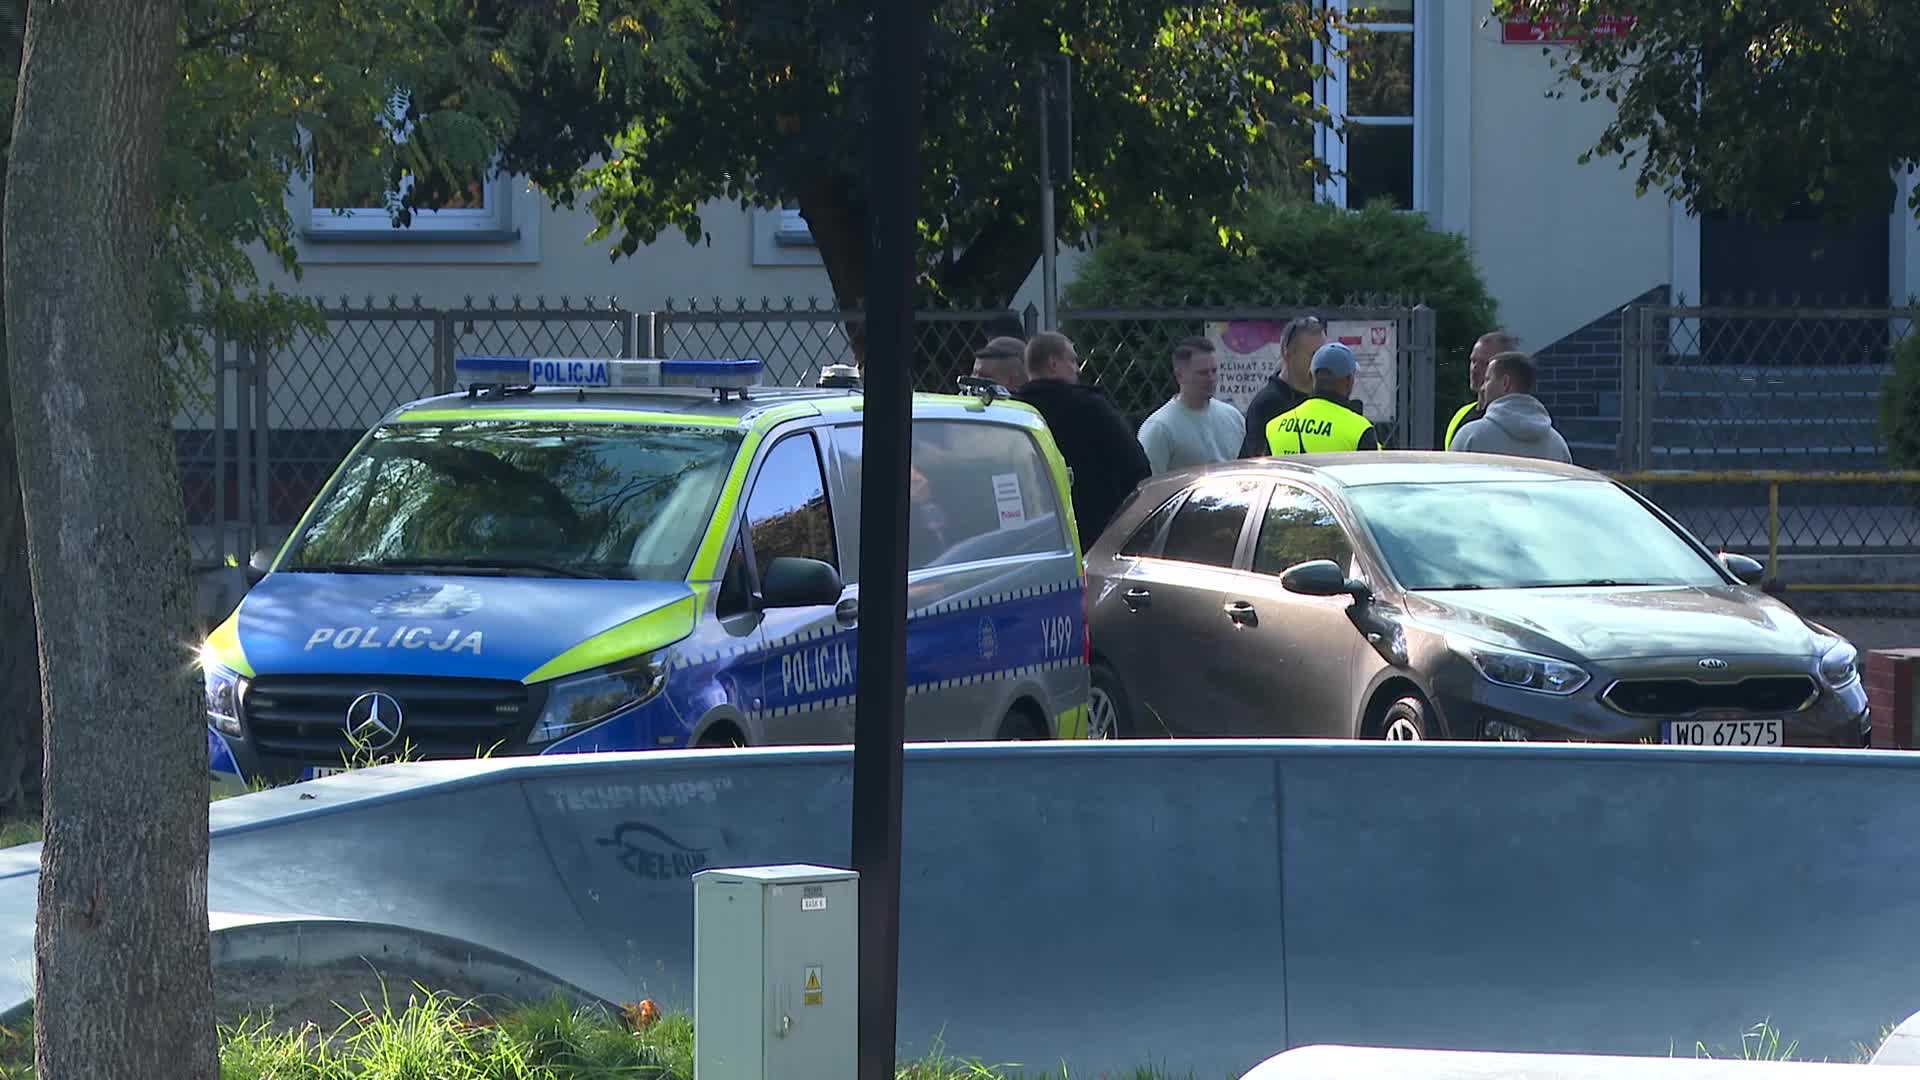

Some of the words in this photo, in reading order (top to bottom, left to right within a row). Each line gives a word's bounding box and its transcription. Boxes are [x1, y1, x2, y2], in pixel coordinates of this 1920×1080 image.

[532, 361, 608, 384] POLICJA
[1219, 361, 1257, 370] KLIMAT
[1278, 418, 1333, 437] POLICJA
[304, 625, 483, 655] POLICJA
[1041, 615, 1073, 657] Y499
[781, 640, 854, 697] POLICJA
[1675, 723, 1704, 745] WO
[1712, 722, 1778, 745] 67575
